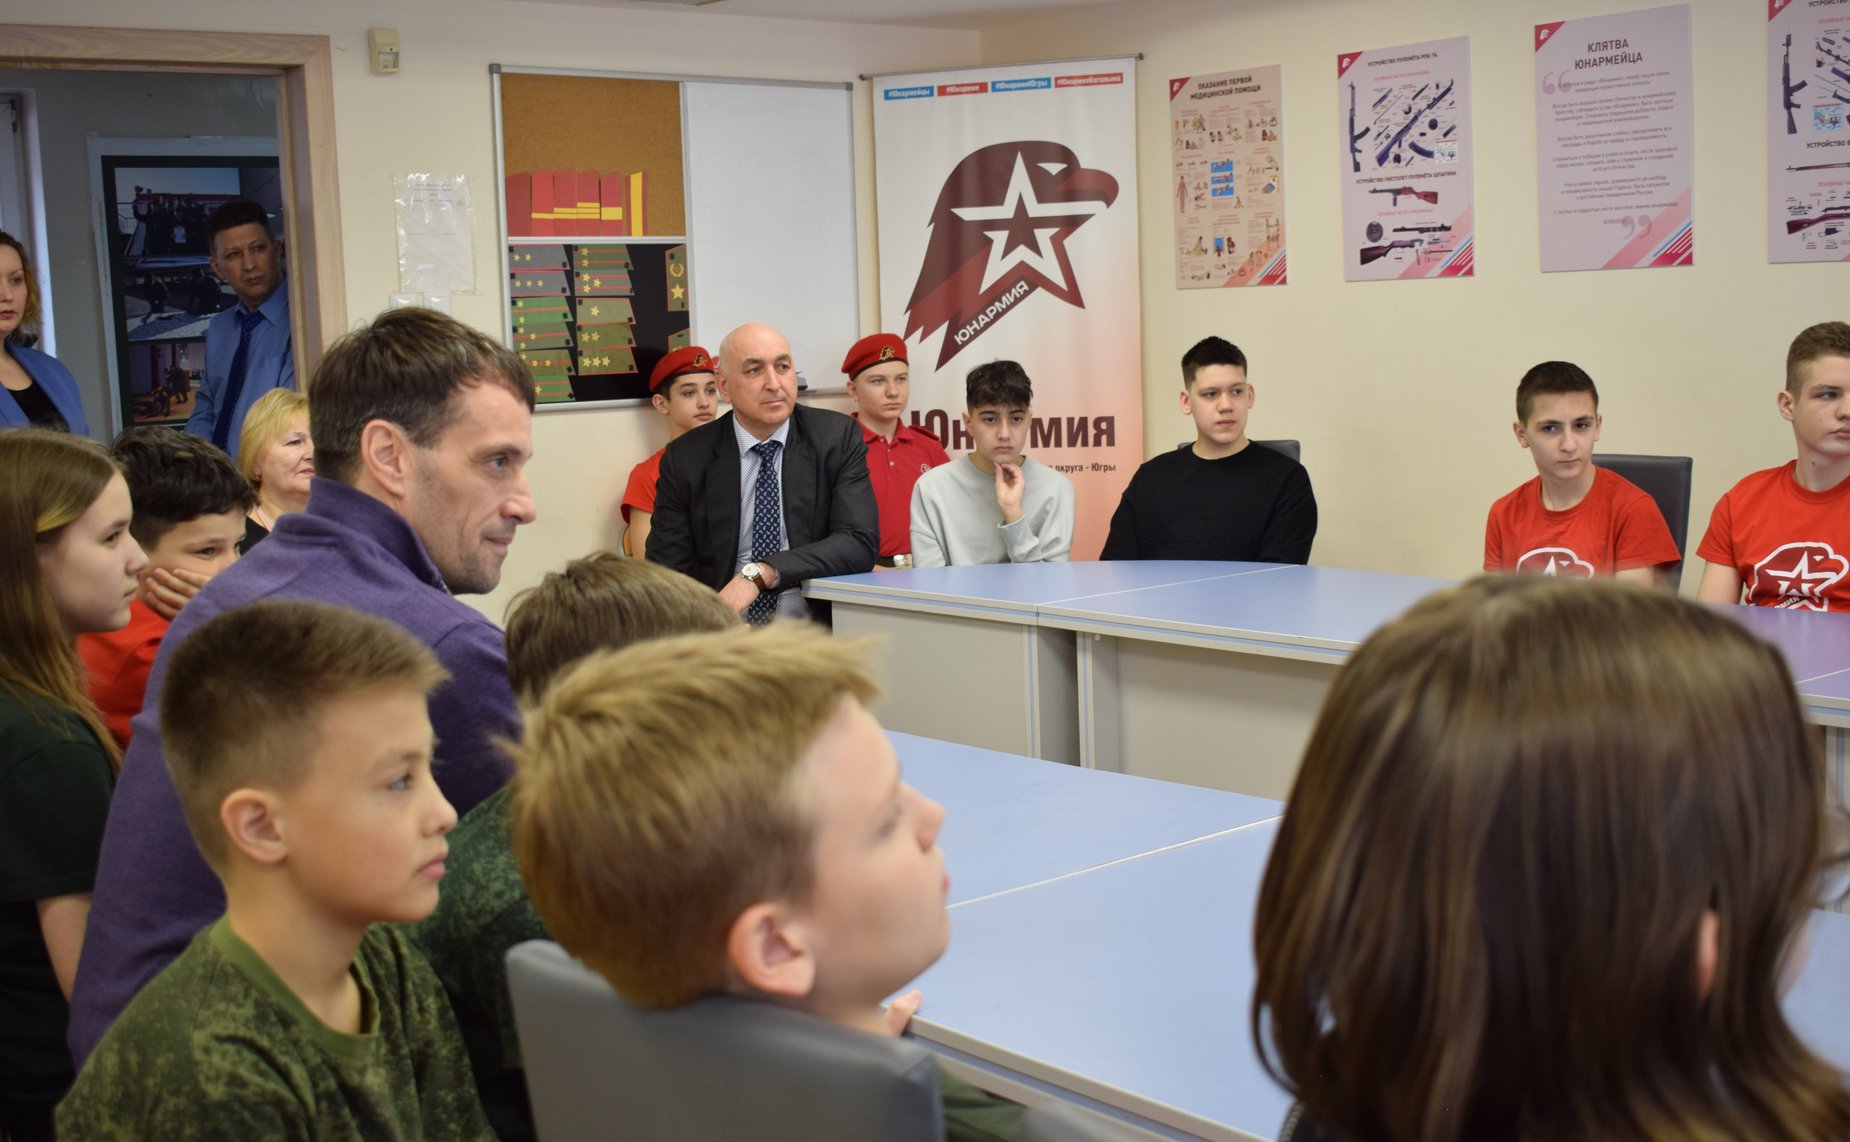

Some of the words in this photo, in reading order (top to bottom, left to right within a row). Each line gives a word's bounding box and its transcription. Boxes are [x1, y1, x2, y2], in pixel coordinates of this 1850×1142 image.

[1587, 38, 1629, 53] КЛЯТВА
[1574, 52, 1643, 70] ЮНАРМЕЙЦА
[1198, 80, 1228, 89] ОКАЗАНИЕ
[1229, 75, 1252, 85] ПЕРВОЙ
[1190, 88, 1233, 99] МЕДИЦИНСКОЙ
[1234, 85, 1261, 93] ПОМОЩИ
[1806, 139, 1846, 149] УСТРОЙСТВО
[954, 280, 1029, 345] ЮНАРМИЯ
[910, 408, 1116, 450] Юнмия
[1055, 464, 1084, 474] округа
[1091, 462, 1116, 473] Югры
